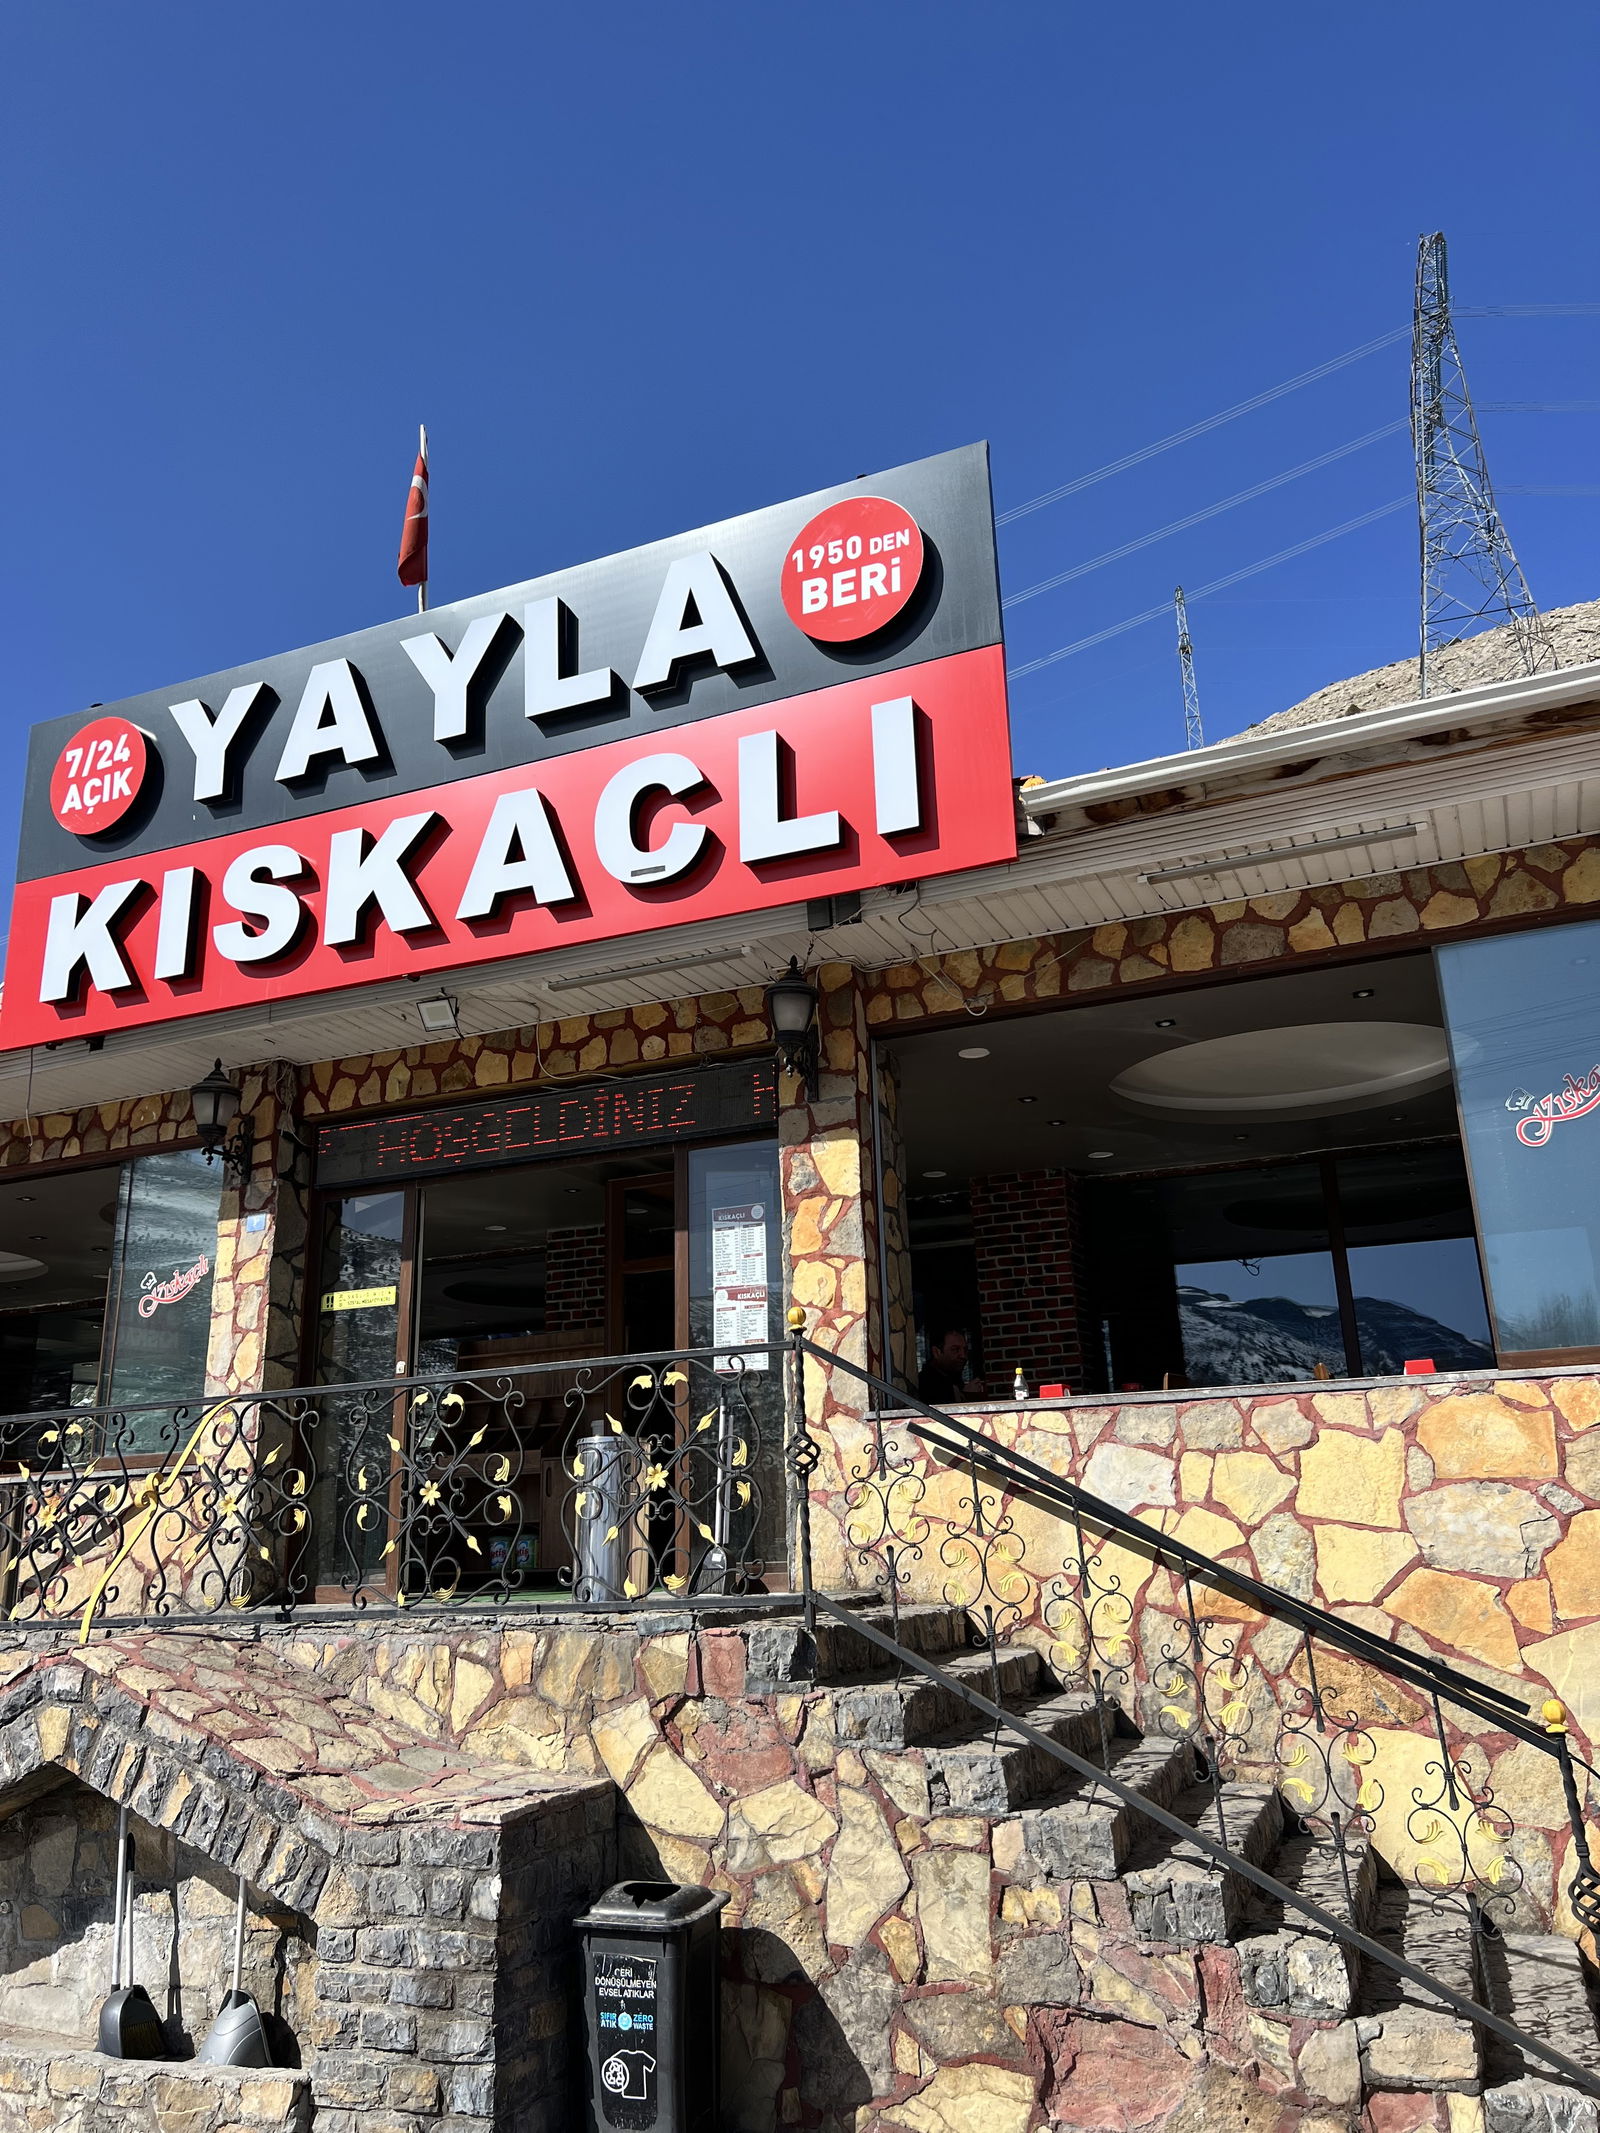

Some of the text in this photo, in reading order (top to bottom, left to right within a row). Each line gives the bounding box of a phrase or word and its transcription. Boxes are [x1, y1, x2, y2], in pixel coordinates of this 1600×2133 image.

[792, 528, 910, 573] 1950 DEN
[168, 551, 757, 803] YAYLA
[65, 733, 131, 779] 7/24
[60, 766, 134, 815] AÇIK
[598, 1987, 655, 1999] EVSEL ATIKLAR
[600, 2019, 617, 2028] ATIK
[633, 2014, 654, 2023] ZERO
[633, 2022, 654, 2031] WASTE
